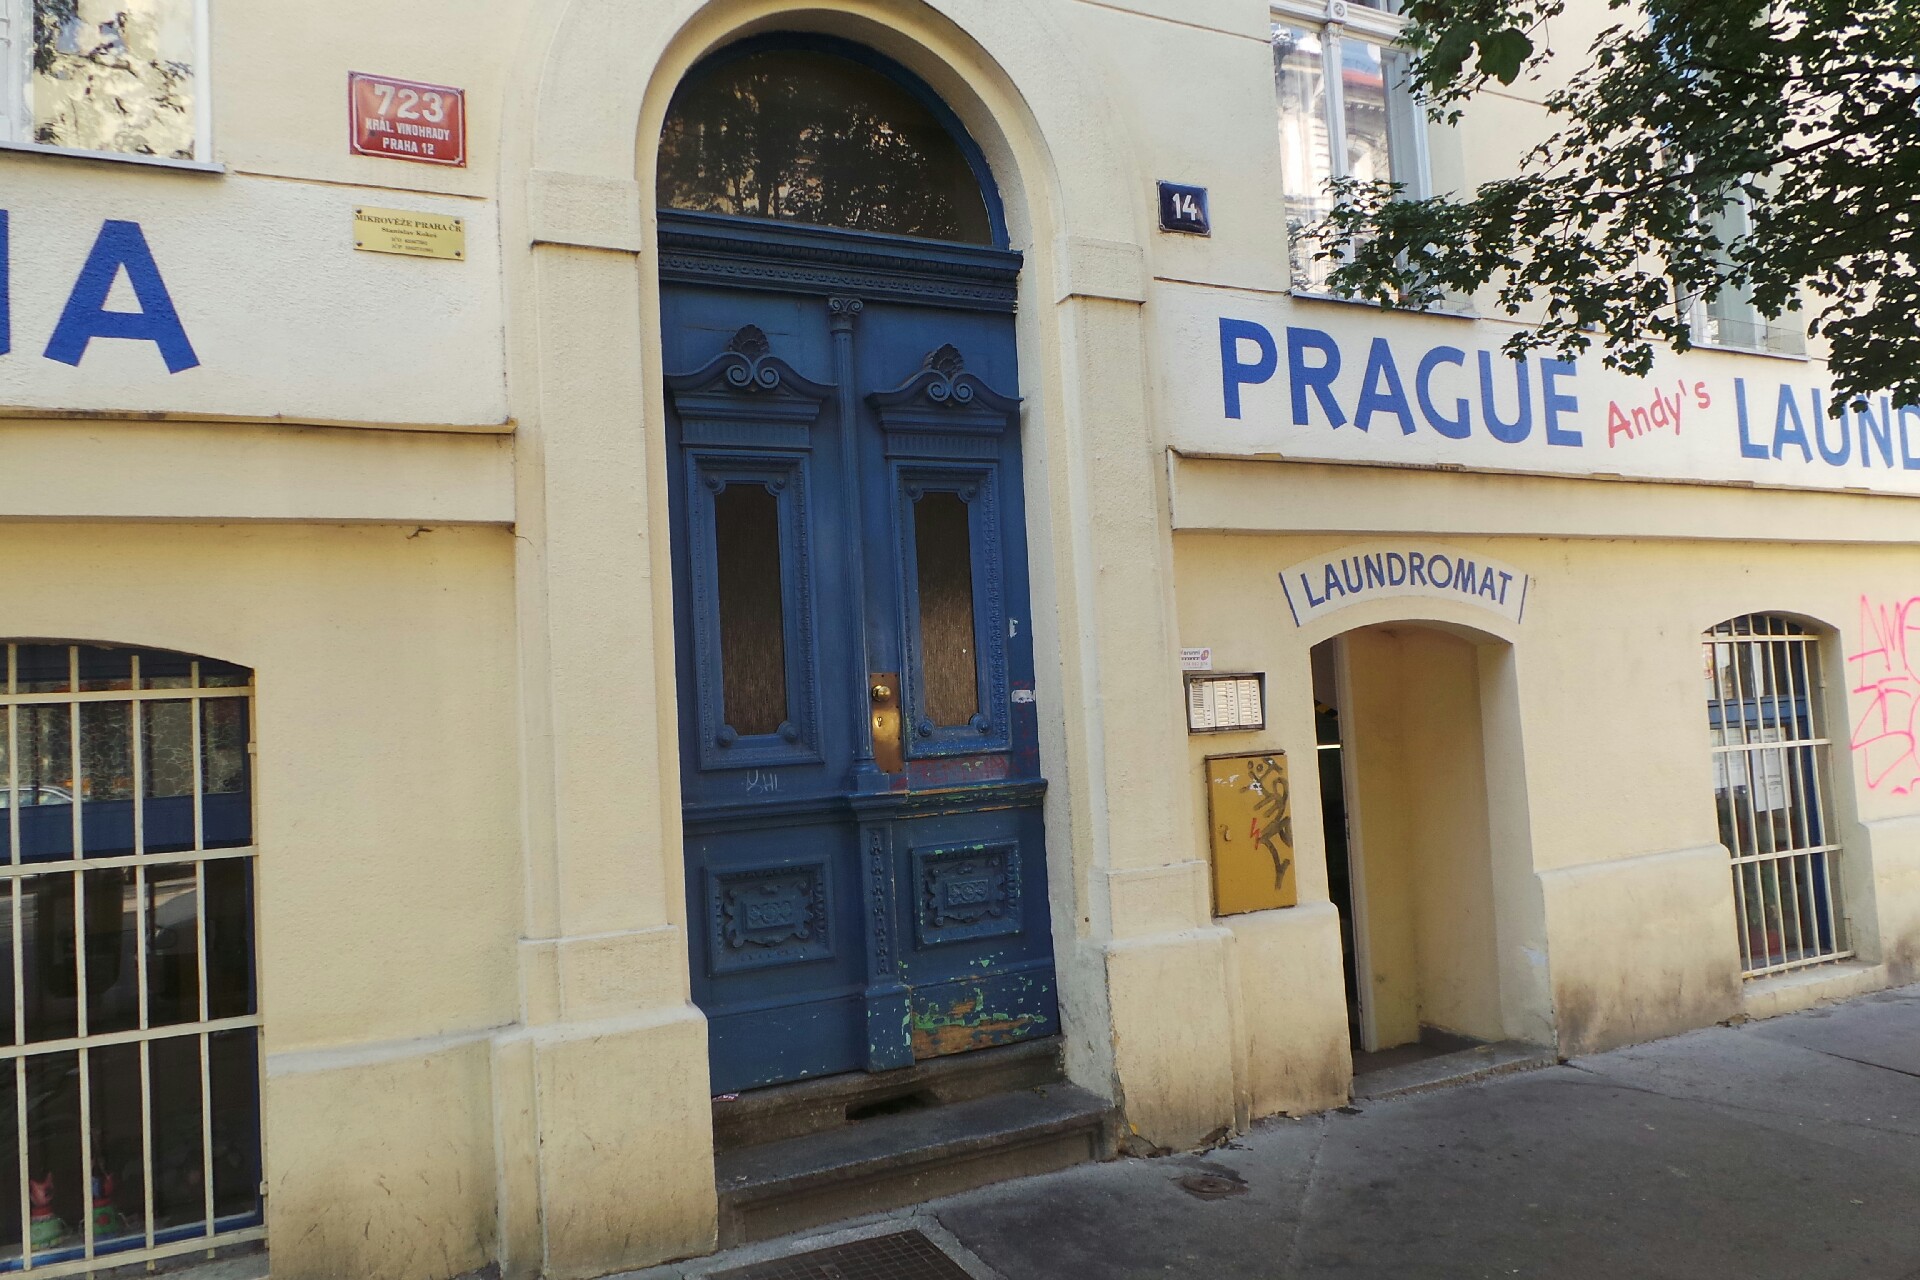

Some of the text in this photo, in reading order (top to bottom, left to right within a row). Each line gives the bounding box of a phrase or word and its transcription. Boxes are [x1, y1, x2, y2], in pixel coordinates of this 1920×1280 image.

[374, 83, 444, 123] 723
[382, 137, 434, 155] PRAHA 12
[396, 121, 450, 141] VINOHRADY
[1172, 193, 1198, 221] 14
[415, 220, 447, 231] PRAHA
[0, 209, 200, 374] A
[1219, 317, 1583, 447] PRAGUE
[1608, 379, 1711, 448] Andy's
[1300, 552, 1513, 608] LAUNDROMAT
